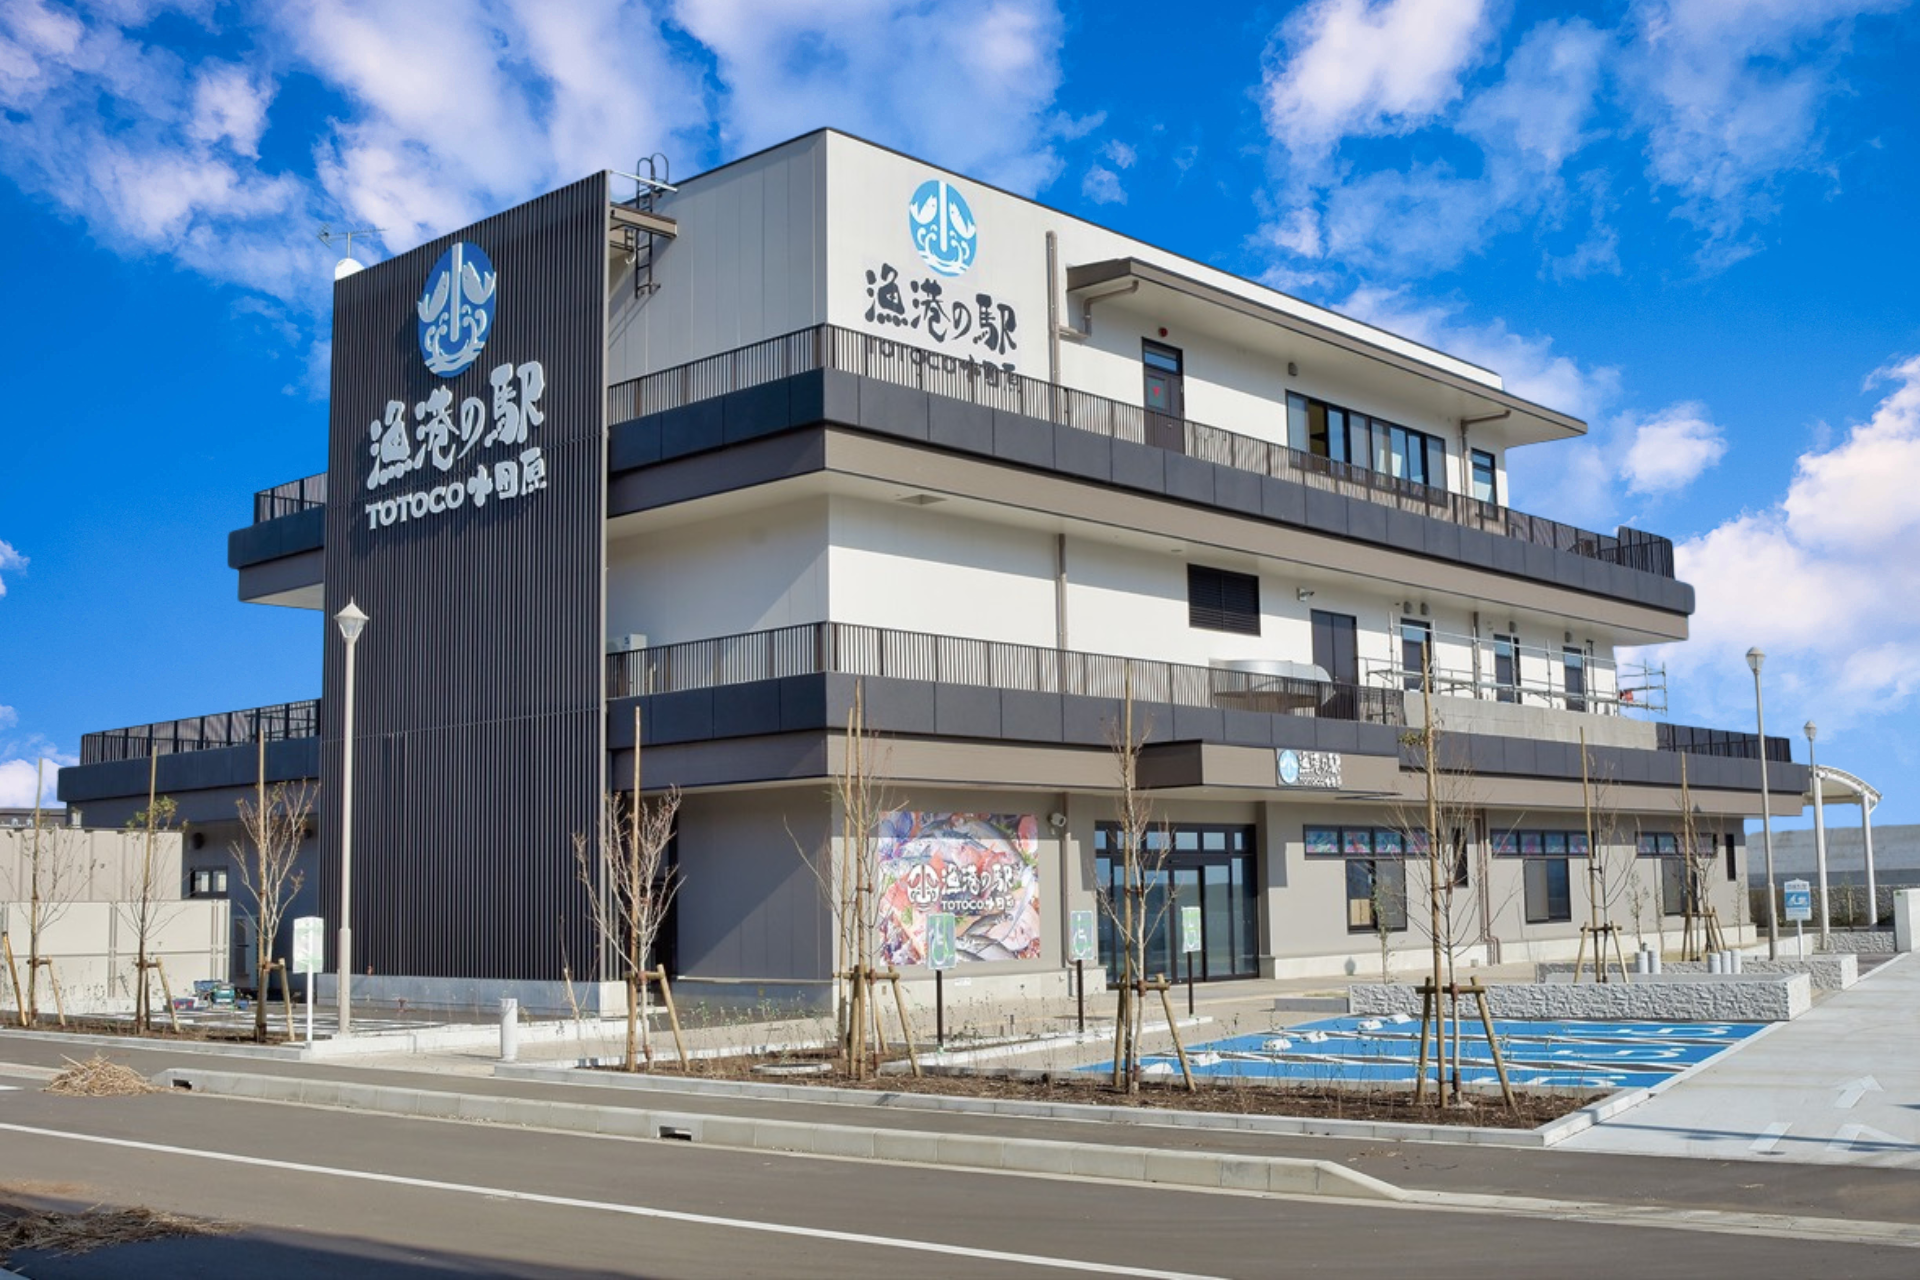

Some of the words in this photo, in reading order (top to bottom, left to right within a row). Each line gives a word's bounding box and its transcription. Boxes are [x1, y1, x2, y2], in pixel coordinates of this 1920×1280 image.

[865, 264, 1017, 355] 漁港の駅
[367, 361, 545, 489] 漁港の駅
